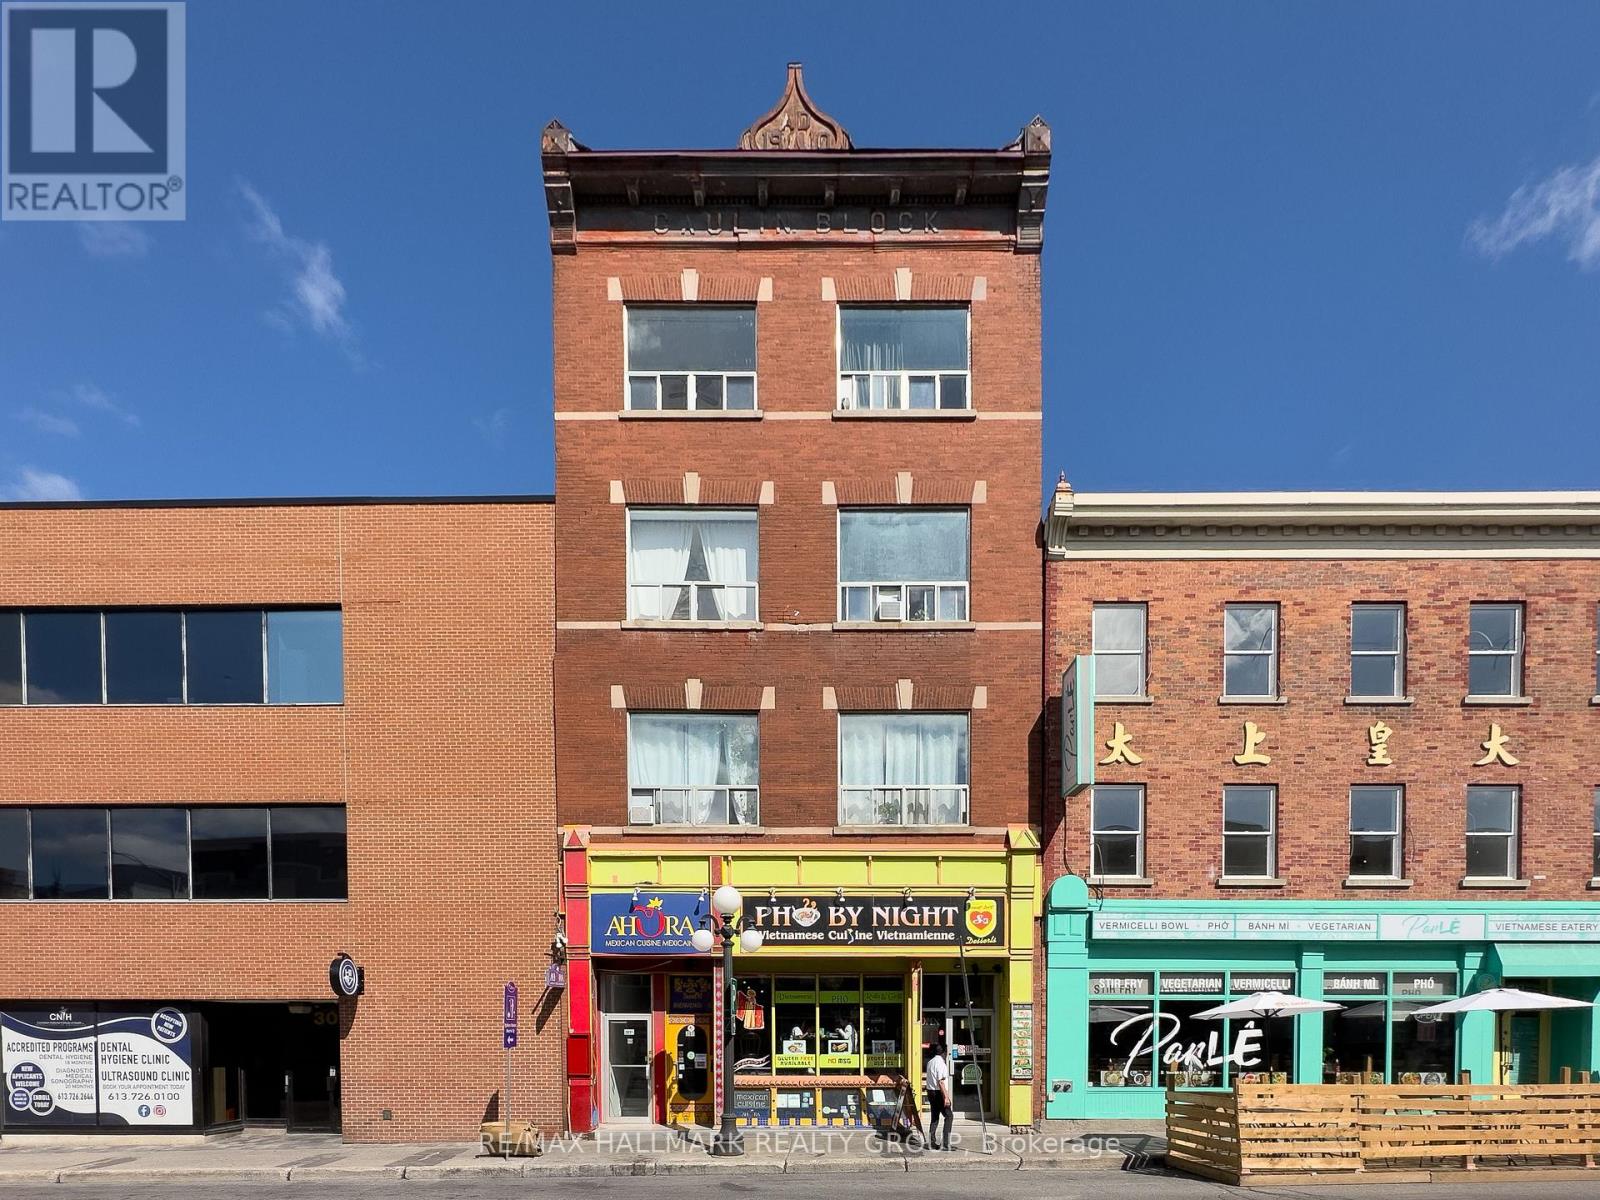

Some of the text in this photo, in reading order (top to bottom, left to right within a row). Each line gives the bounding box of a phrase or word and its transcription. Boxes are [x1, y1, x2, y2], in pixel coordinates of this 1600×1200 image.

[815, 211, 939, 234] BLOCK
[828, 906, 864, 926] BY
[871, 905, 959, 926] NIGHT
[1099, 922, 1158, 930] VERMICELLI
[1161, 922, 1189, 930] BOWL
[1308, 923, 1371, 931] VEGETARIAN
[1495, 922, 1599, 932] VIETNAMESE EATERY
[758, 930, 825, 940] Vietnamese
[876, 930, 955, 940] Vietnamienne
[966, 936, 997, 944] Desserts
[605, 939, 636, 947] MEXICAN
[636, 939, 661, 947] CUISINE
[1162, 978, 1222, 989] VEGETARIAN
[1233, 978, 1291, 989] VERMICELLI
[1333, 977, 1361, 989] BÁNH
[313, 1011, 338, 1025] 30
[6, 1042, 94, 1053] ACCREDITED PROGRAMS
[100, 1042, 133, 1052] DENTAL
[101, 1055, 170, 1064] HYGIENE CLINIC
[101, 1071, 190, 1081] ULTRASOUND CLINIC
[108, 1092, 180, 1100] 613.726.0100
